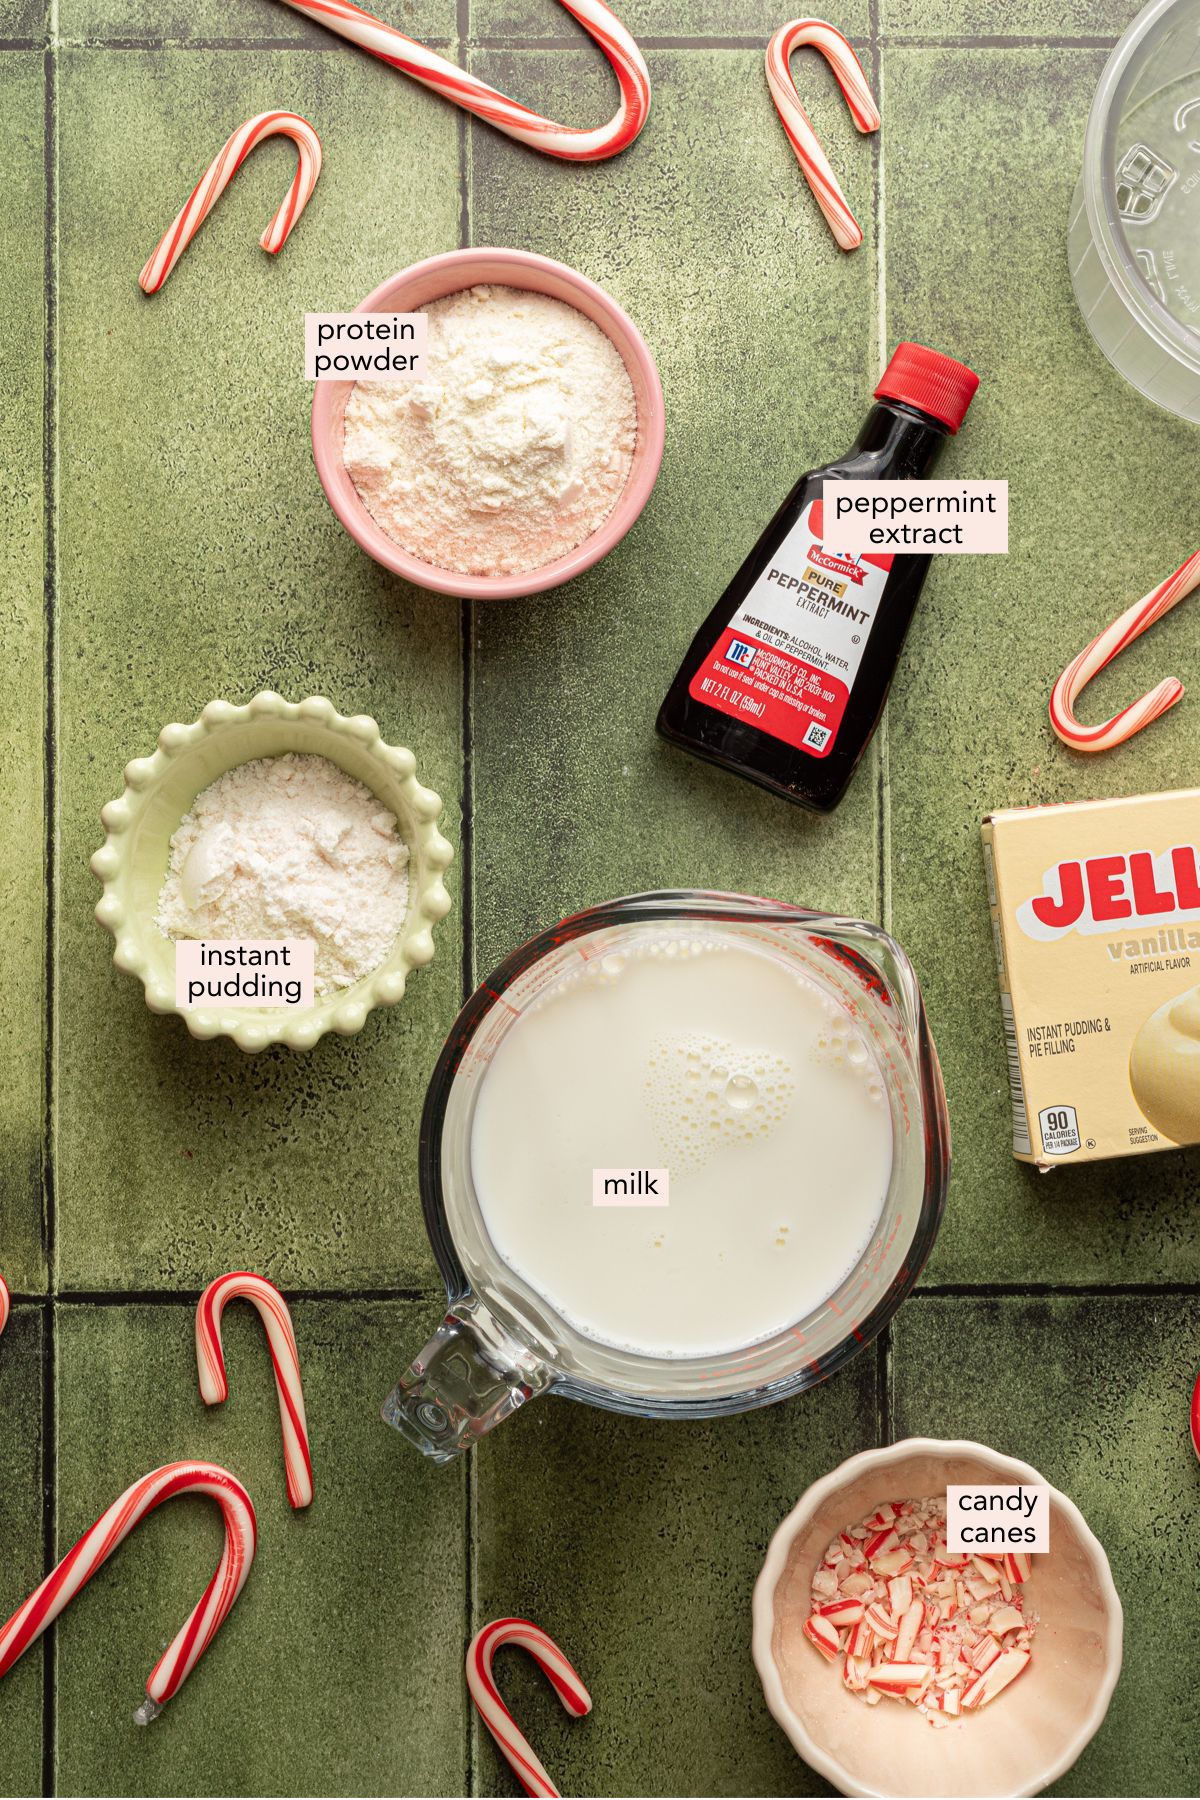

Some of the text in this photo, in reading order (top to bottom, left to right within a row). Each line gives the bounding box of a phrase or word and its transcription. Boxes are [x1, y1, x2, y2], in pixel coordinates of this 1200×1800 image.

[807, 571, 842, 594] PURE
[766, 568, 870, 625] PEPPERMINT
[796, 596, 830, 619] EXTRACT
[742, 613, 849, 671] INGREDIENTS: ALCOHOL, WATER,
[755, 630, 829, 671] & OIL OF PEPPERMINT.
[752, 655, 769, 670] HUNT
[713, 660, 721, 671] Do
[720, 665, 730, 675] not
[728, 669, 739, 679] use
[738, 671, 744, 681] if
[742, 674, 755, 686] seal
[754, 680, 770, 692] under
[768, 687, 780, 699] cap
[778, 690, 785, 700] is
[783, 694, 804, 711] missing
[802, 703, 810, 712] or
[754, 667, 780, 686] PACKED
[778, 679, 788, 690] IN
[700, 677, 766, 719] NET 2 FL OZ (59mL)
[1130, 957, 1191, 975] ARTIFICIAL FLAVOR
[1026, 1017, 1111, 1042] INSTANT PUDDING &
[1029, 1038, 1076, 1058] PIE FILLING
[1047, 1110, 1069, 1131] 90
[1128, 1126, 1148, 1137] SERVING
[1044, 1128, 1077, 1141] CALORIES
[1129, 1135, 1159, 1145] SUGGESTION
